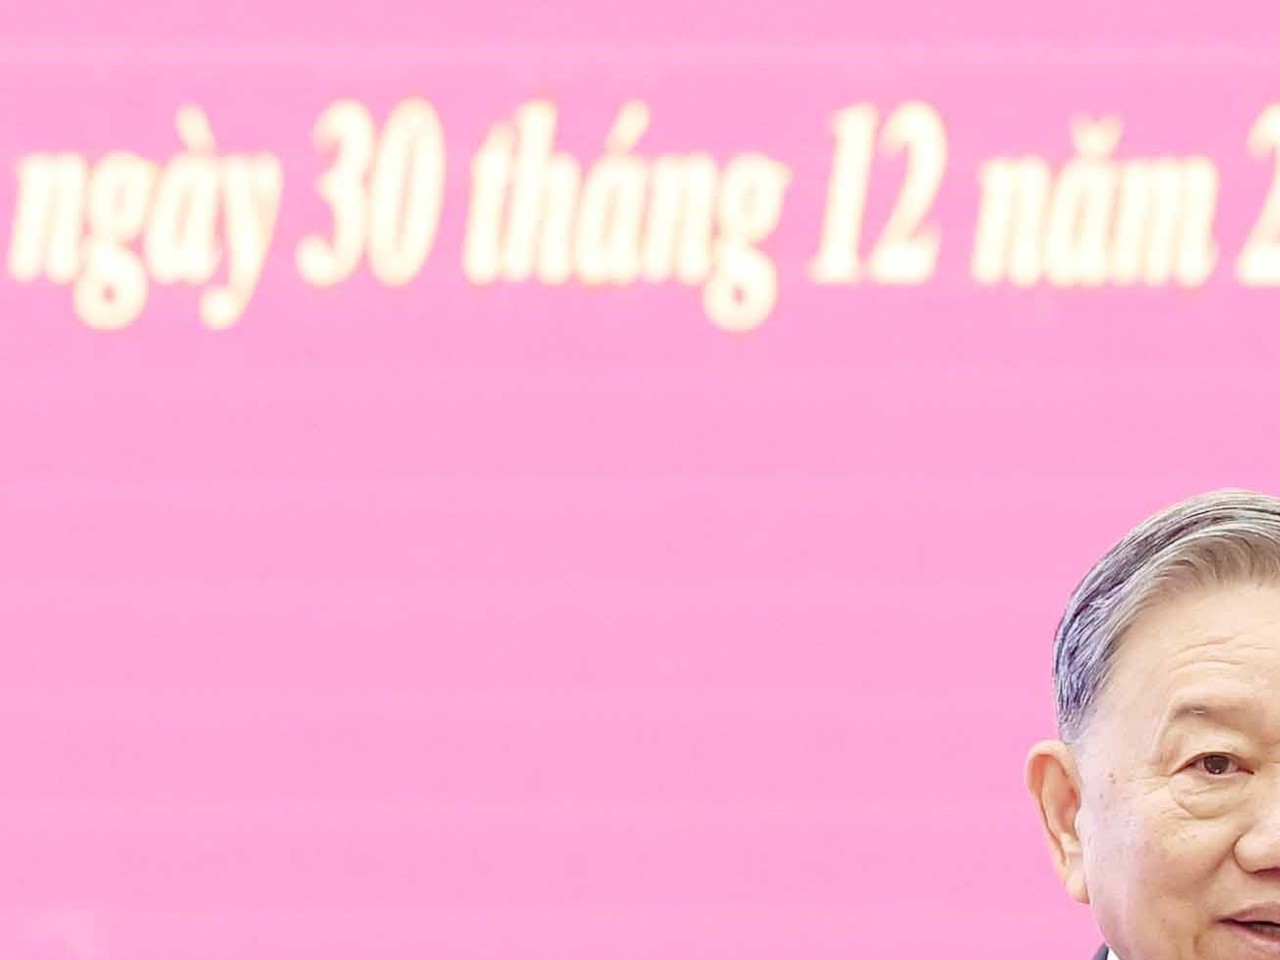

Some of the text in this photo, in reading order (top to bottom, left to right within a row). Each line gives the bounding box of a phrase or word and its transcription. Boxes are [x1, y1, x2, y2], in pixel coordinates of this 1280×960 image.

[7, 103, 284, 329] ngày
[295, 97, 446, 286] 30
[462, 99, 792, 331] tháng
[808, 100, 948, 285] 12
[970, 115, 1219, 288] năm
